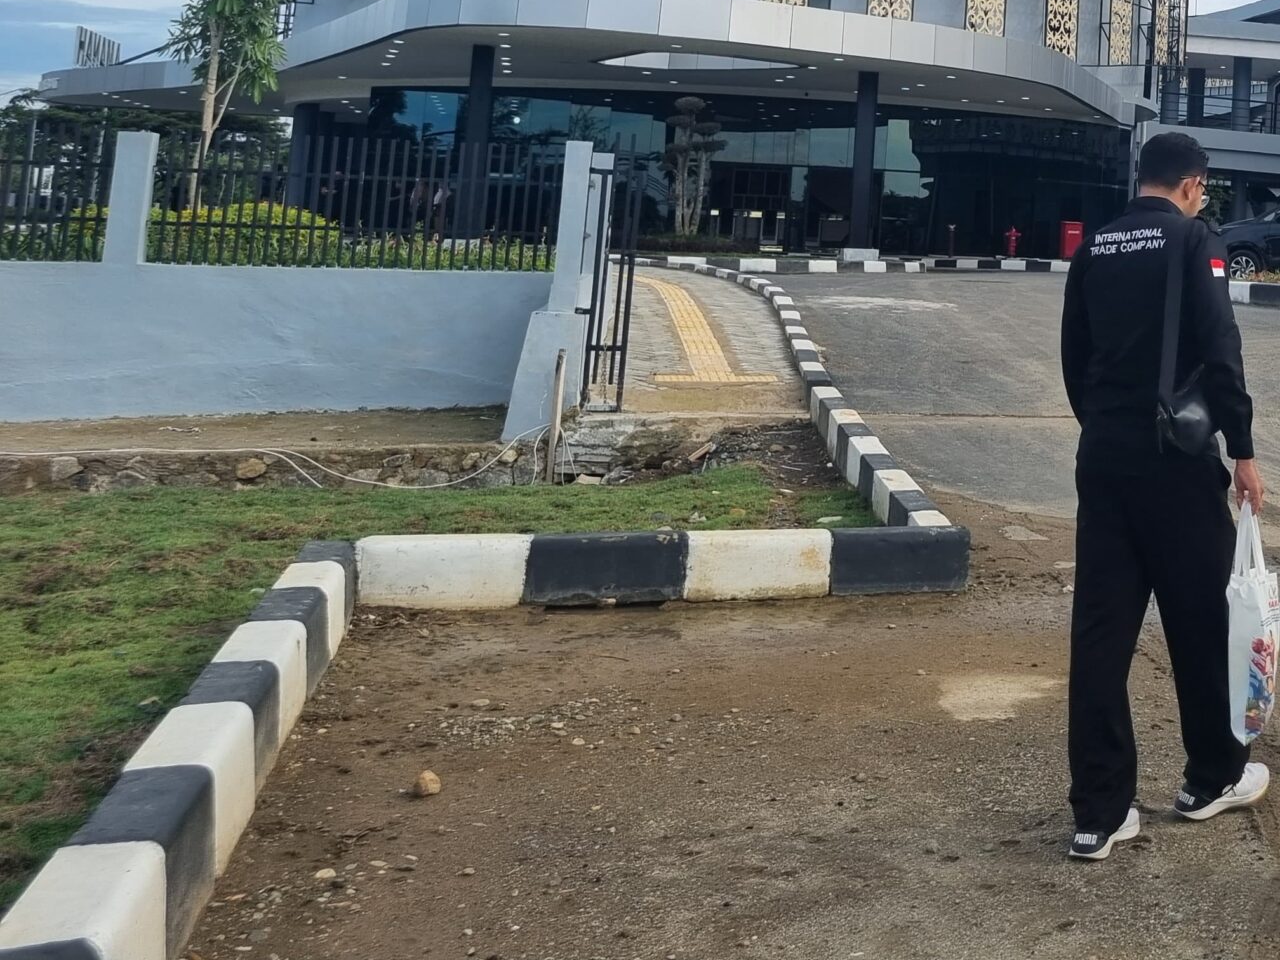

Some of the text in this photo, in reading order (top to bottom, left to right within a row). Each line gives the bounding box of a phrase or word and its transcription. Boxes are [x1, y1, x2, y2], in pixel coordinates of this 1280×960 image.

[1094, 227, 1163, 245] INTERNATIONAL
[1090, 238, 1167, 256] TRADE COMPANY
[1074, 833, 1098, 845] PUMA
